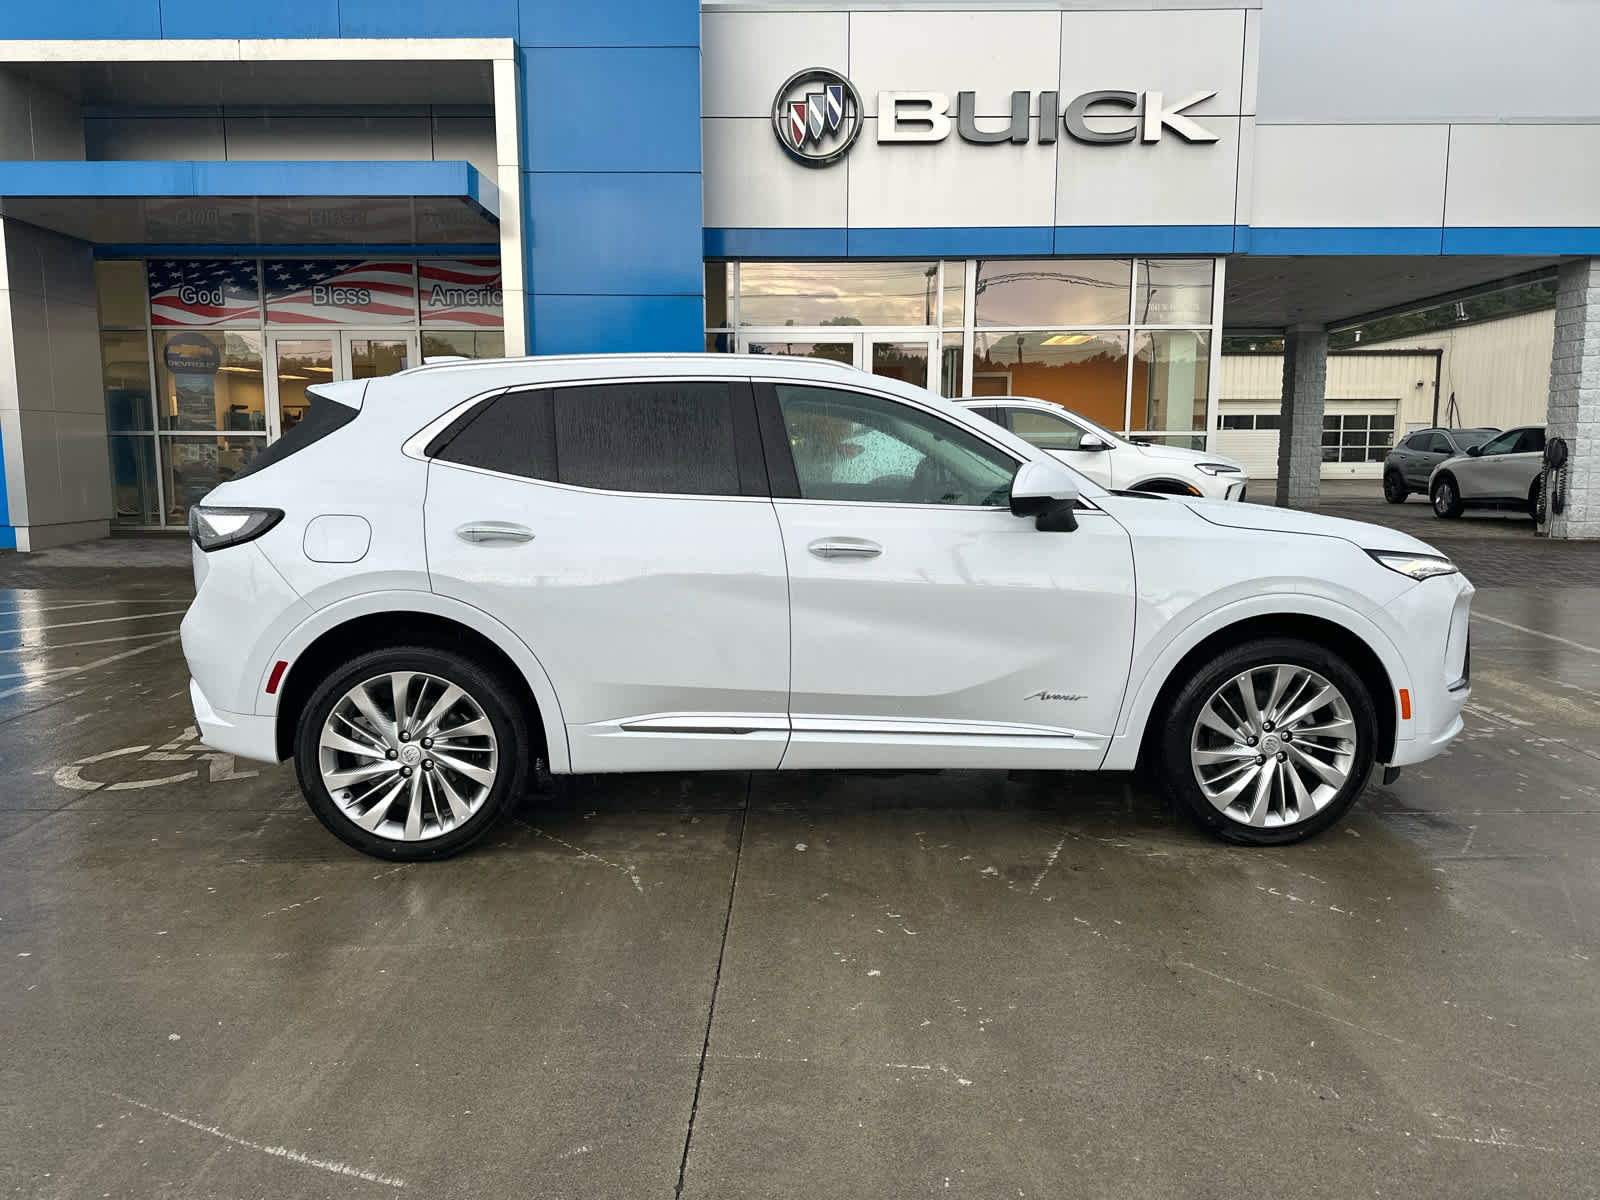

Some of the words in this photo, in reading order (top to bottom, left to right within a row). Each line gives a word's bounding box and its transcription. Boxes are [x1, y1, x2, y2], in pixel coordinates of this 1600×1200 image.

[877, 90, 1222, 146] BUICK
[178, 284, 226, 306] God
[312, 284, 371, 305] Bless
